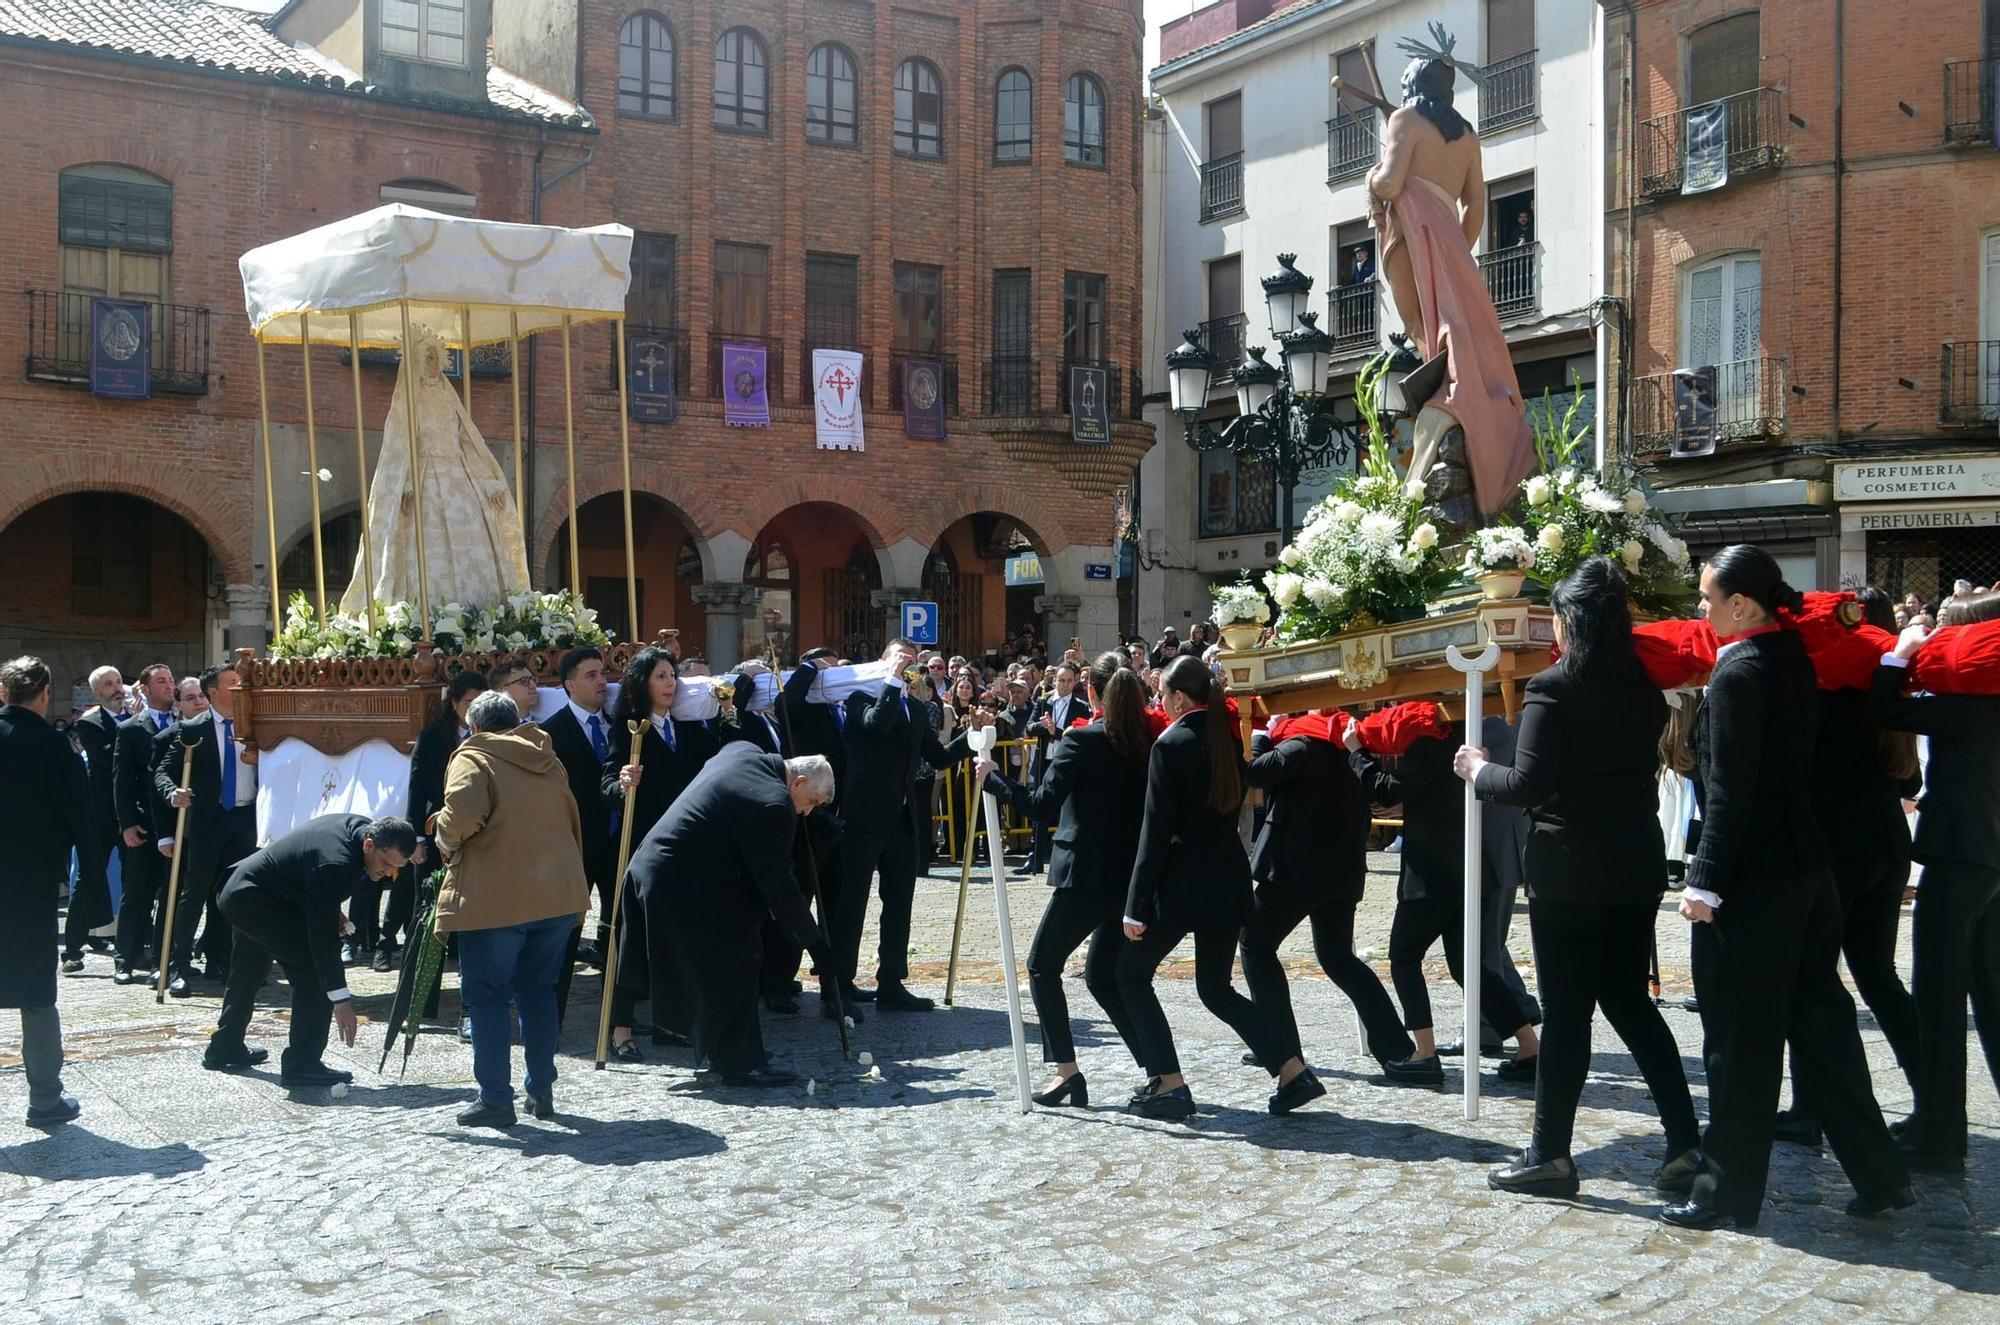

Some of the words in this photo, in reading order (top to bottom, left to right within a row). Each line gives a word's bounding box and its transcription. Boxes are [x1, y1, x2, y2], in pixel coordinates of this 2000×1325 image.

[1857, 464, 1966, 478] PERFUMERIA
[1864, 481, 1957, 493] COSMETICA
[1860, 512, 1974, 529] PERFUMERIA
[907, 606, 928, 637] P
